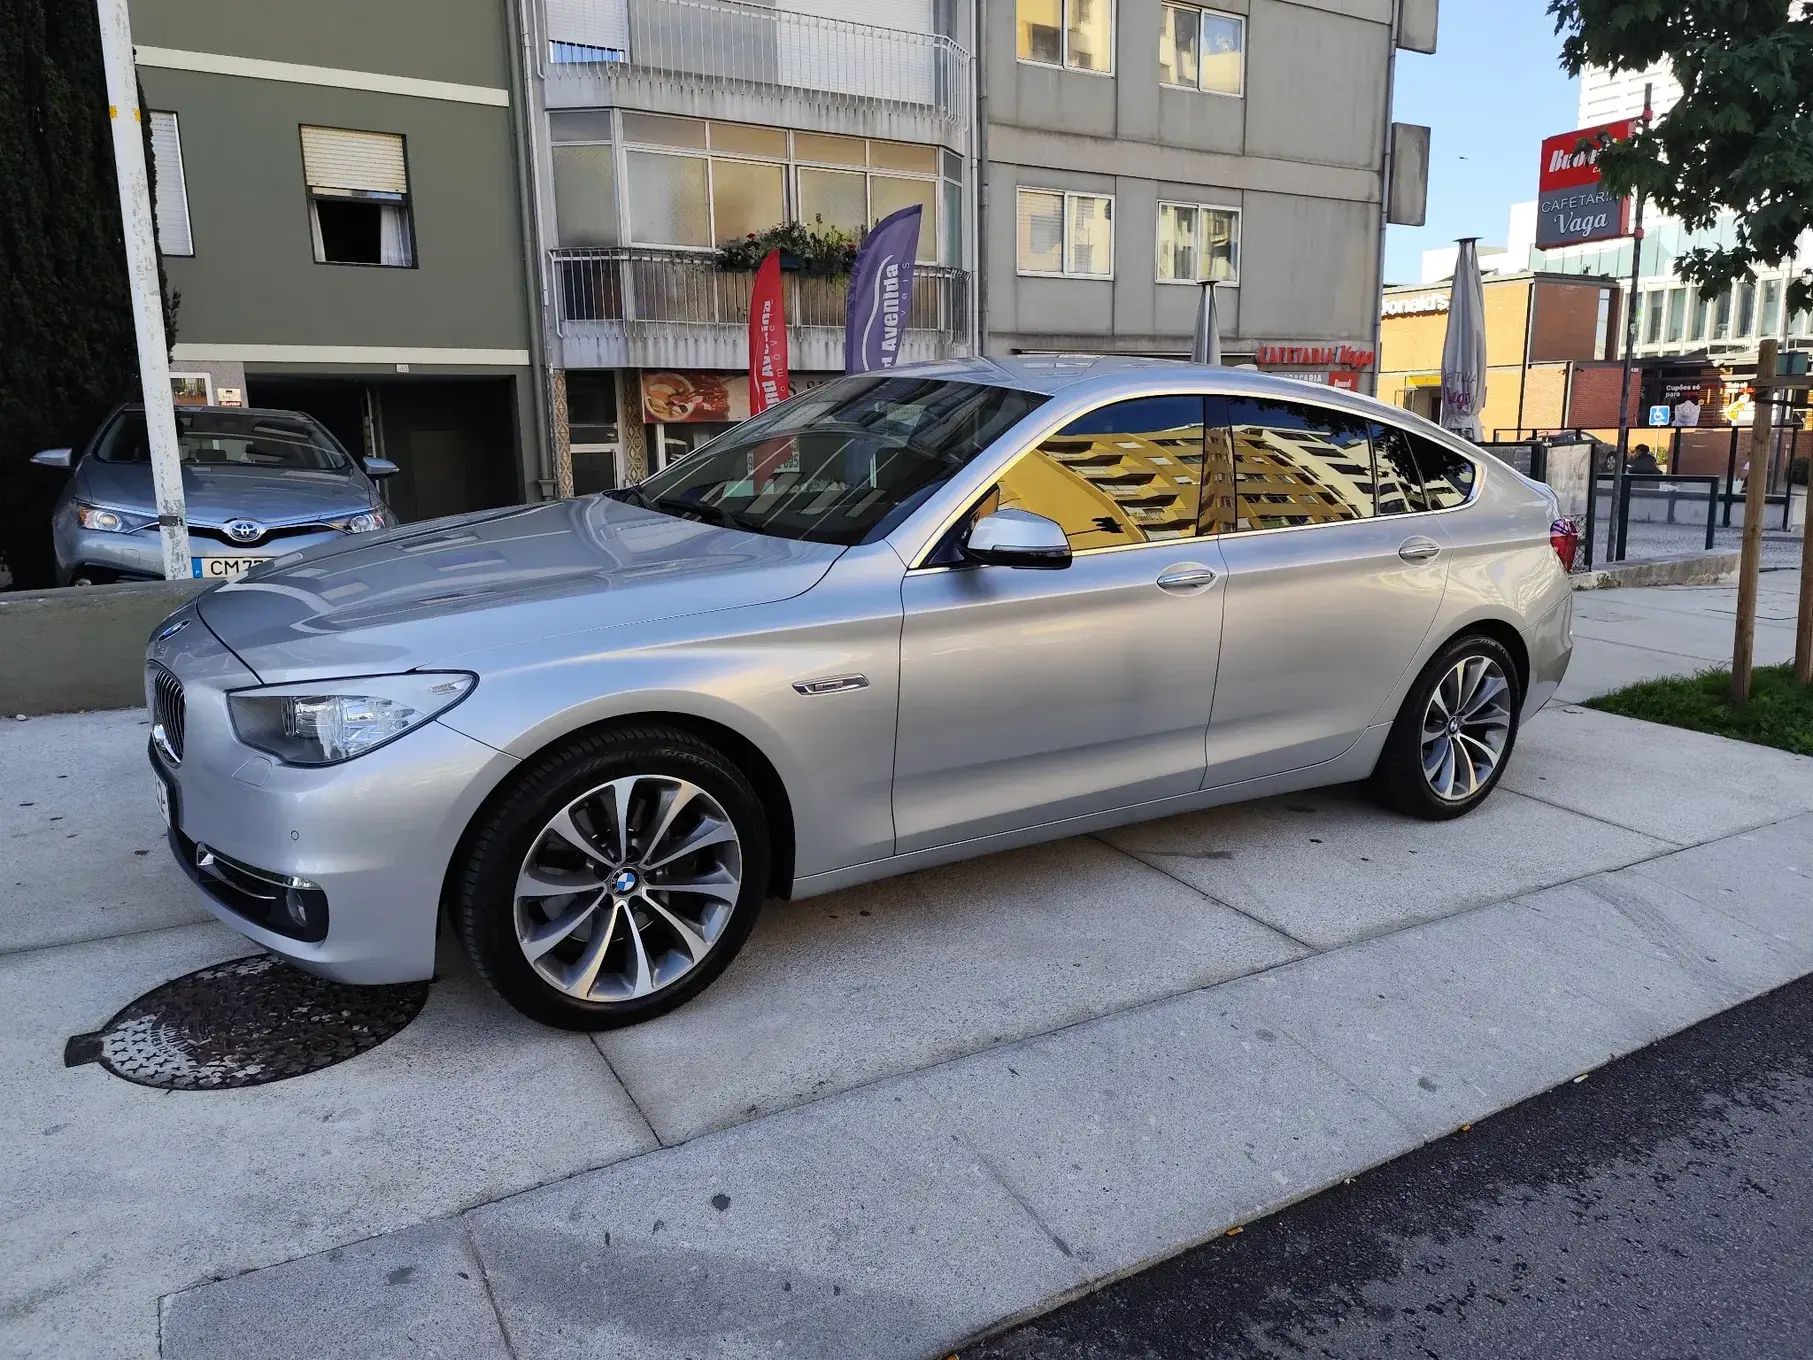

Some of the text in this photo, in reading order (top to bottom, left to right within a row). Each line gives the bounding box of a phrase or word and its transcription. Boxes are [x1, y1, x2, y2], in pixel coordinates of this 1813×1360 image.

[1554, 212, 1609, 237] Vaga
[881, 263, 899, 352] Avenida
[1340, 345, 1375, 368] Vaga
[1665, 384, 1691, 392] Cupões
